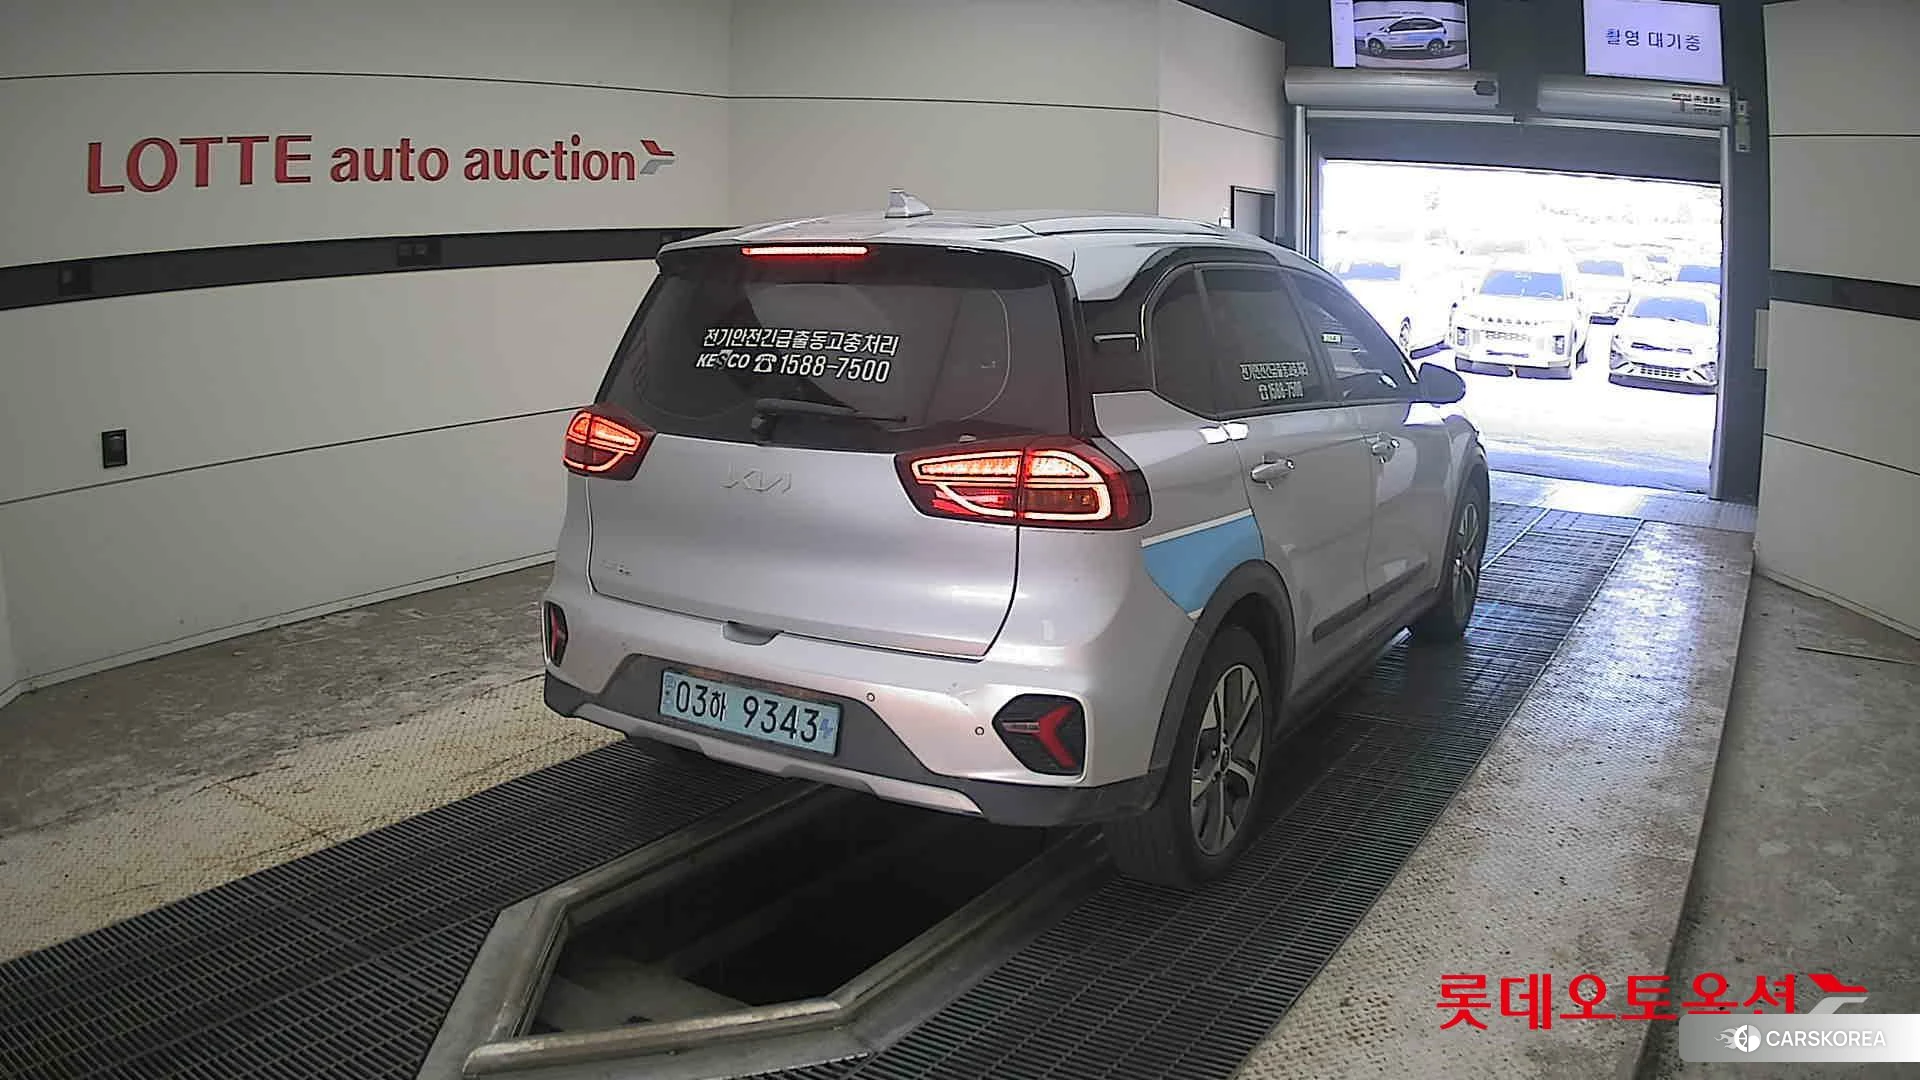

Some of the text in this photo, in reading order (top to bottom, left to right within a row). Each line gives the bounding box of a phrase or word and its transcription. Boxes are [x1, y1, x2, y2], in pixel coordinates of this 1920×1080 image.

[1648, 31, 1701, 52] 대기중
[87, 134, 636, 194] LOTTE auto auction
[703, 328, 900, 356] 전기안전긴급출동고충처리
[779, 354, 890, 382] 1588-7500
[675, 681, 820, 742] 03하 9343
